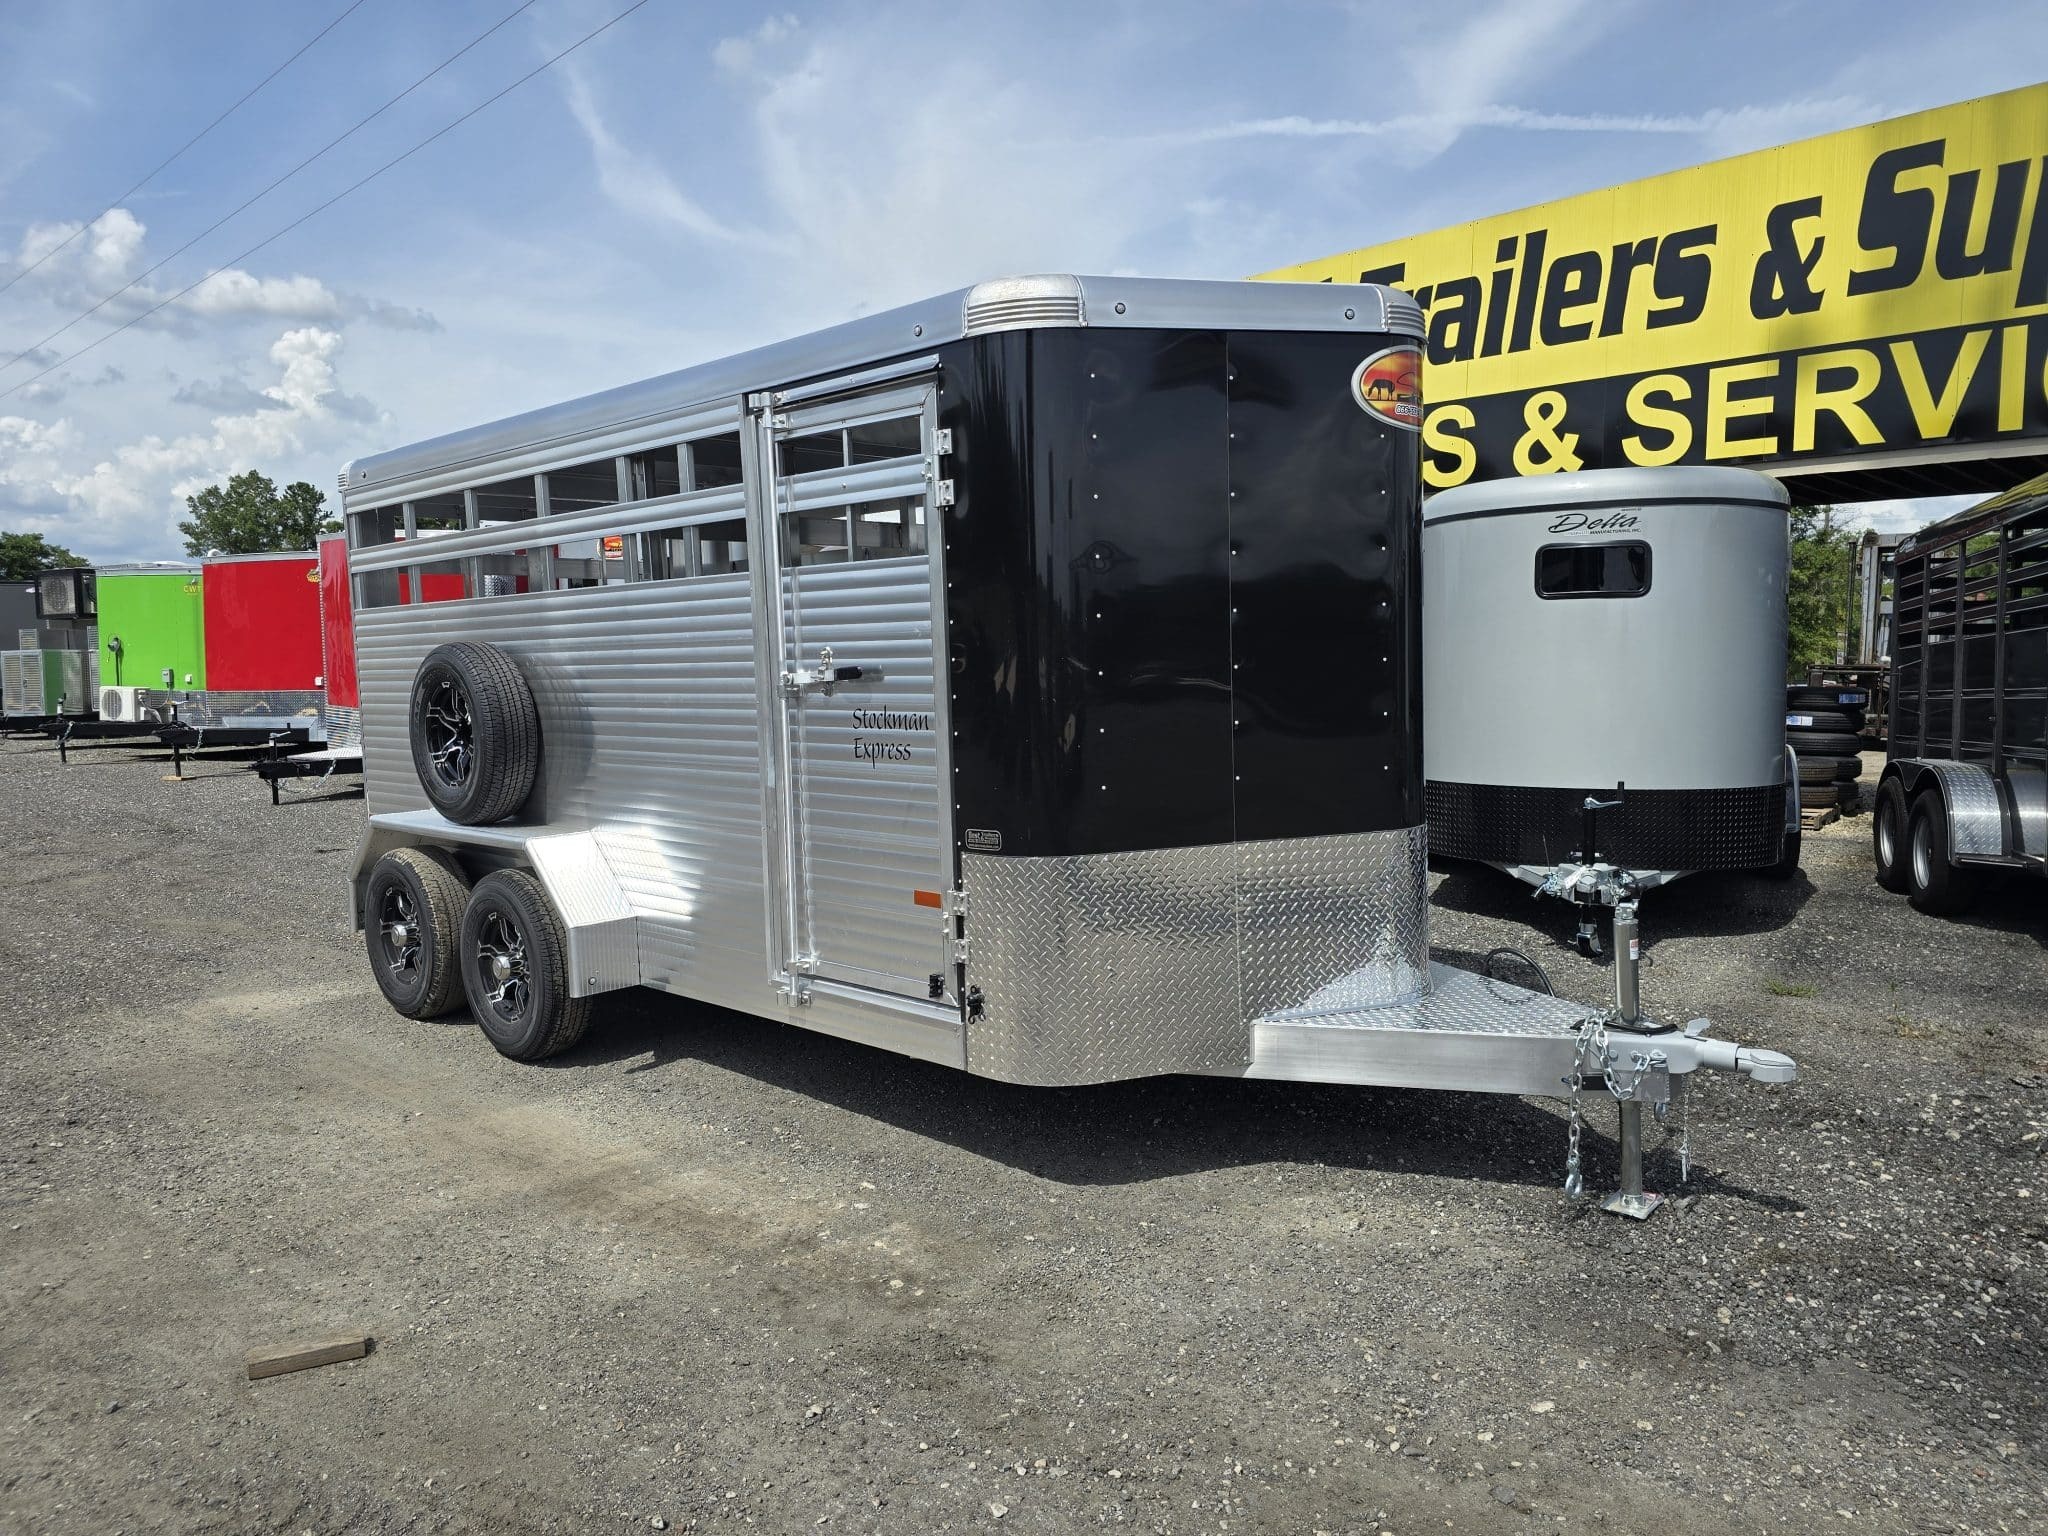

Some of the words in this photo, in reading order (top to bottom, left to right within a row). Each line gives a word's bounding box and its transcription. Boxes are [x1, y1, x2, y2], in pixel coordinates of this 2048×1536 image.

[1750, 195, 1826, 320] &
[1512, 390, 1585, 476] &
[1621, 324, 2048, 467] SERVI
[1548, 513, 1642, 533] Delta
[852, 704, 929, 731] Stockman
[853, 737, 911, 769] Express
